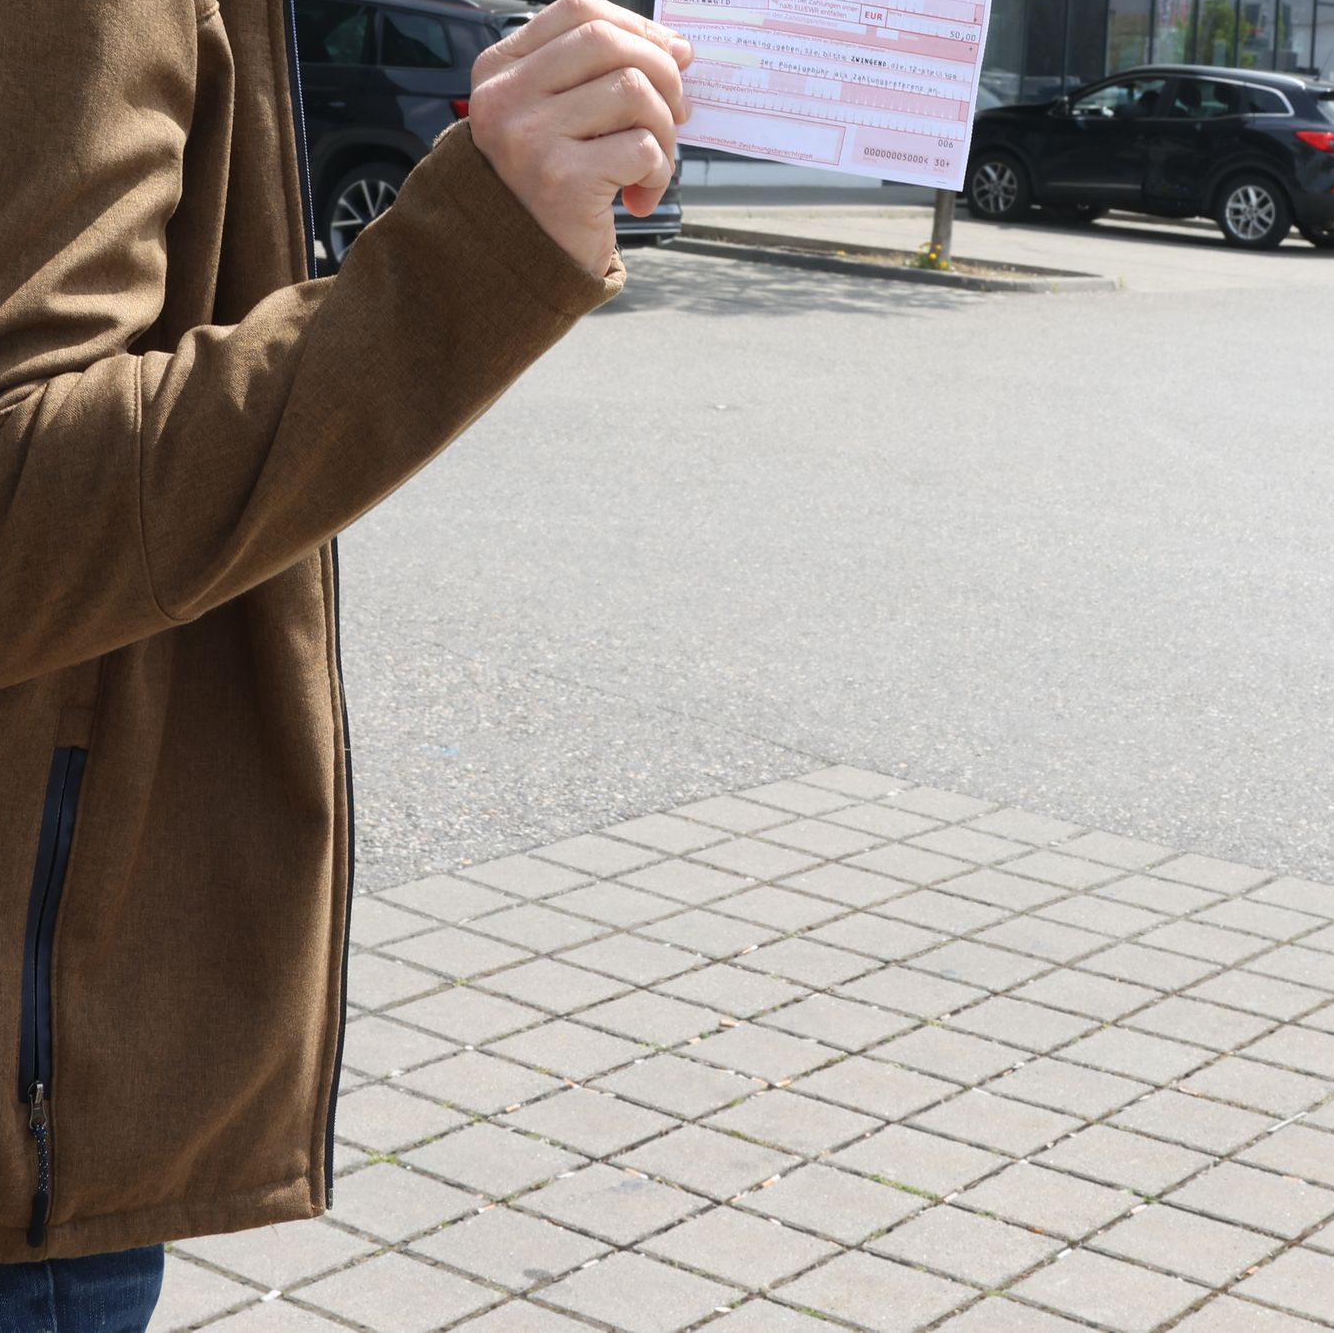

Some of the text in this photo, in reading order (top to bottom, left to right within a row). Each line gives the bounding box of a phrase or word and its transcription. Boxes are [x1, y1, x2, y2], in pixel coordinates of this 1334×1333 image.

[864, 11, 883, 21] EUR
[949, 30, 976, 42] 50,00
[851, 55, 887, 67] ZWINGEND
[938, 139, 954, 148] 006
